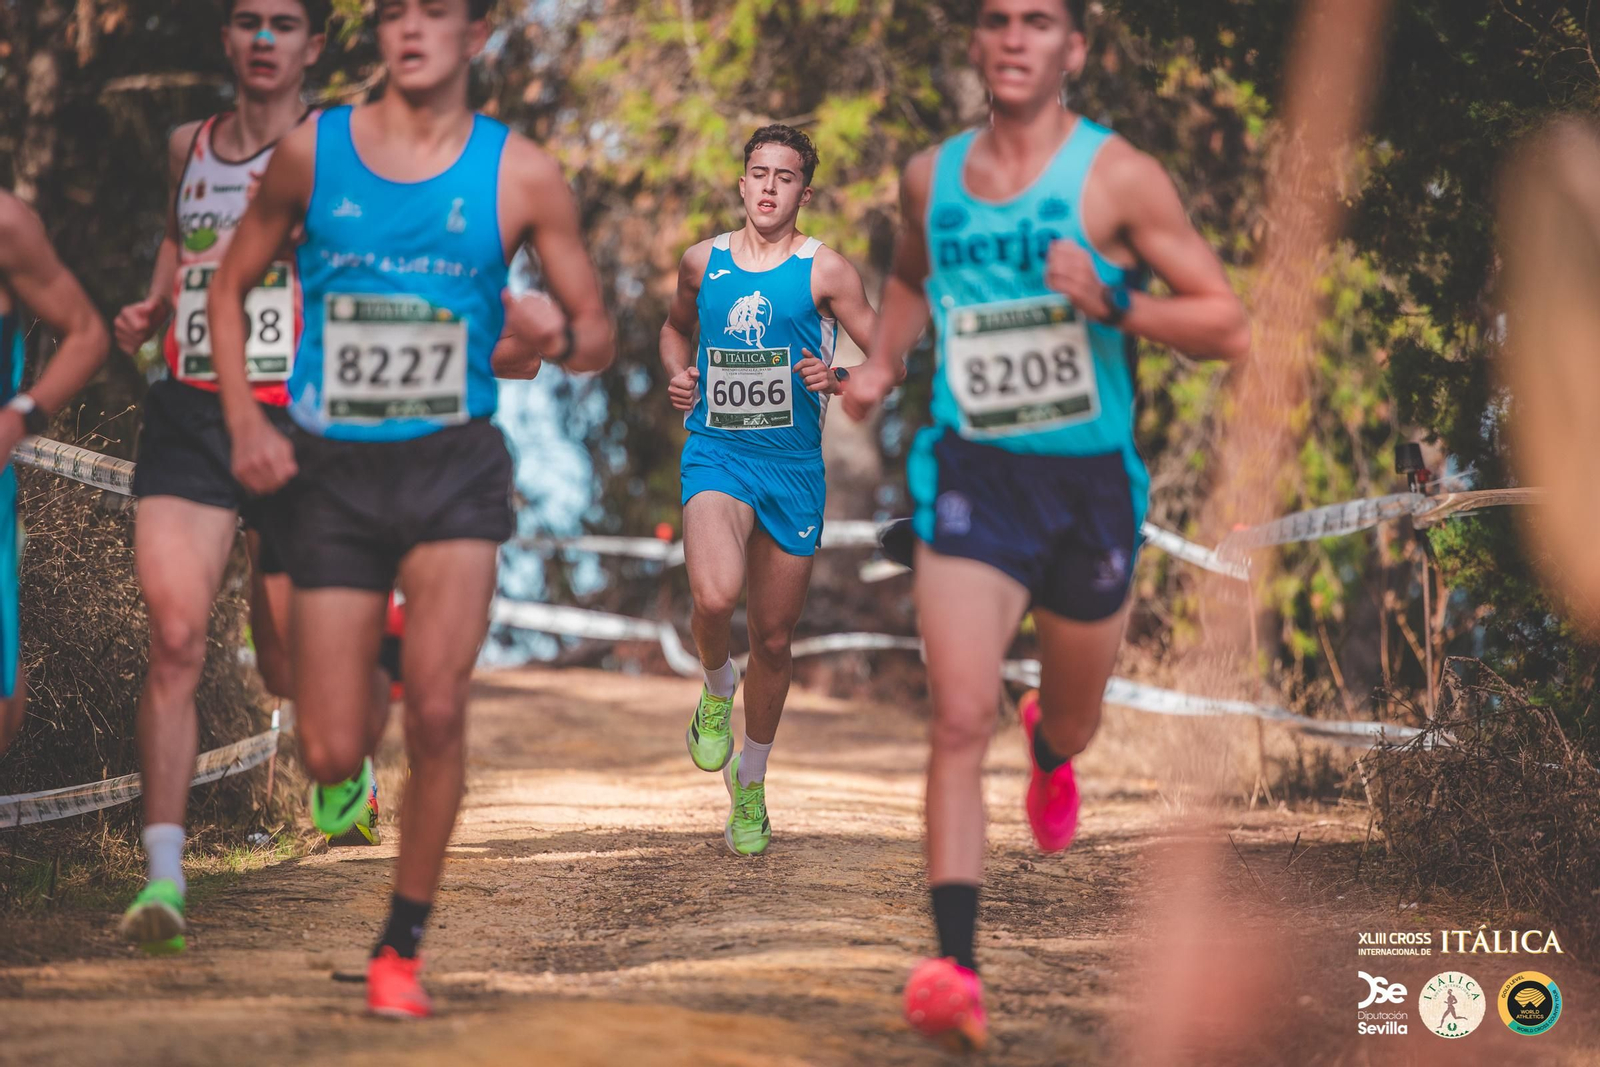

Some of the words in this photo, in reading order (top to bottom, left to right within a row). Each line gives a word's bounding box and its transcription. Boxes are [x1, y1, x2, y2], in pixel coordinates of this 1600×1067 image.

[187, 308, 281, 346] 68
[337, 343, 454, 387] 8227
[725, 352, 766, 363] ITÁLICA
[965, 344, 1080, 398] 8208
[713, 379, 786, 407] 6066
